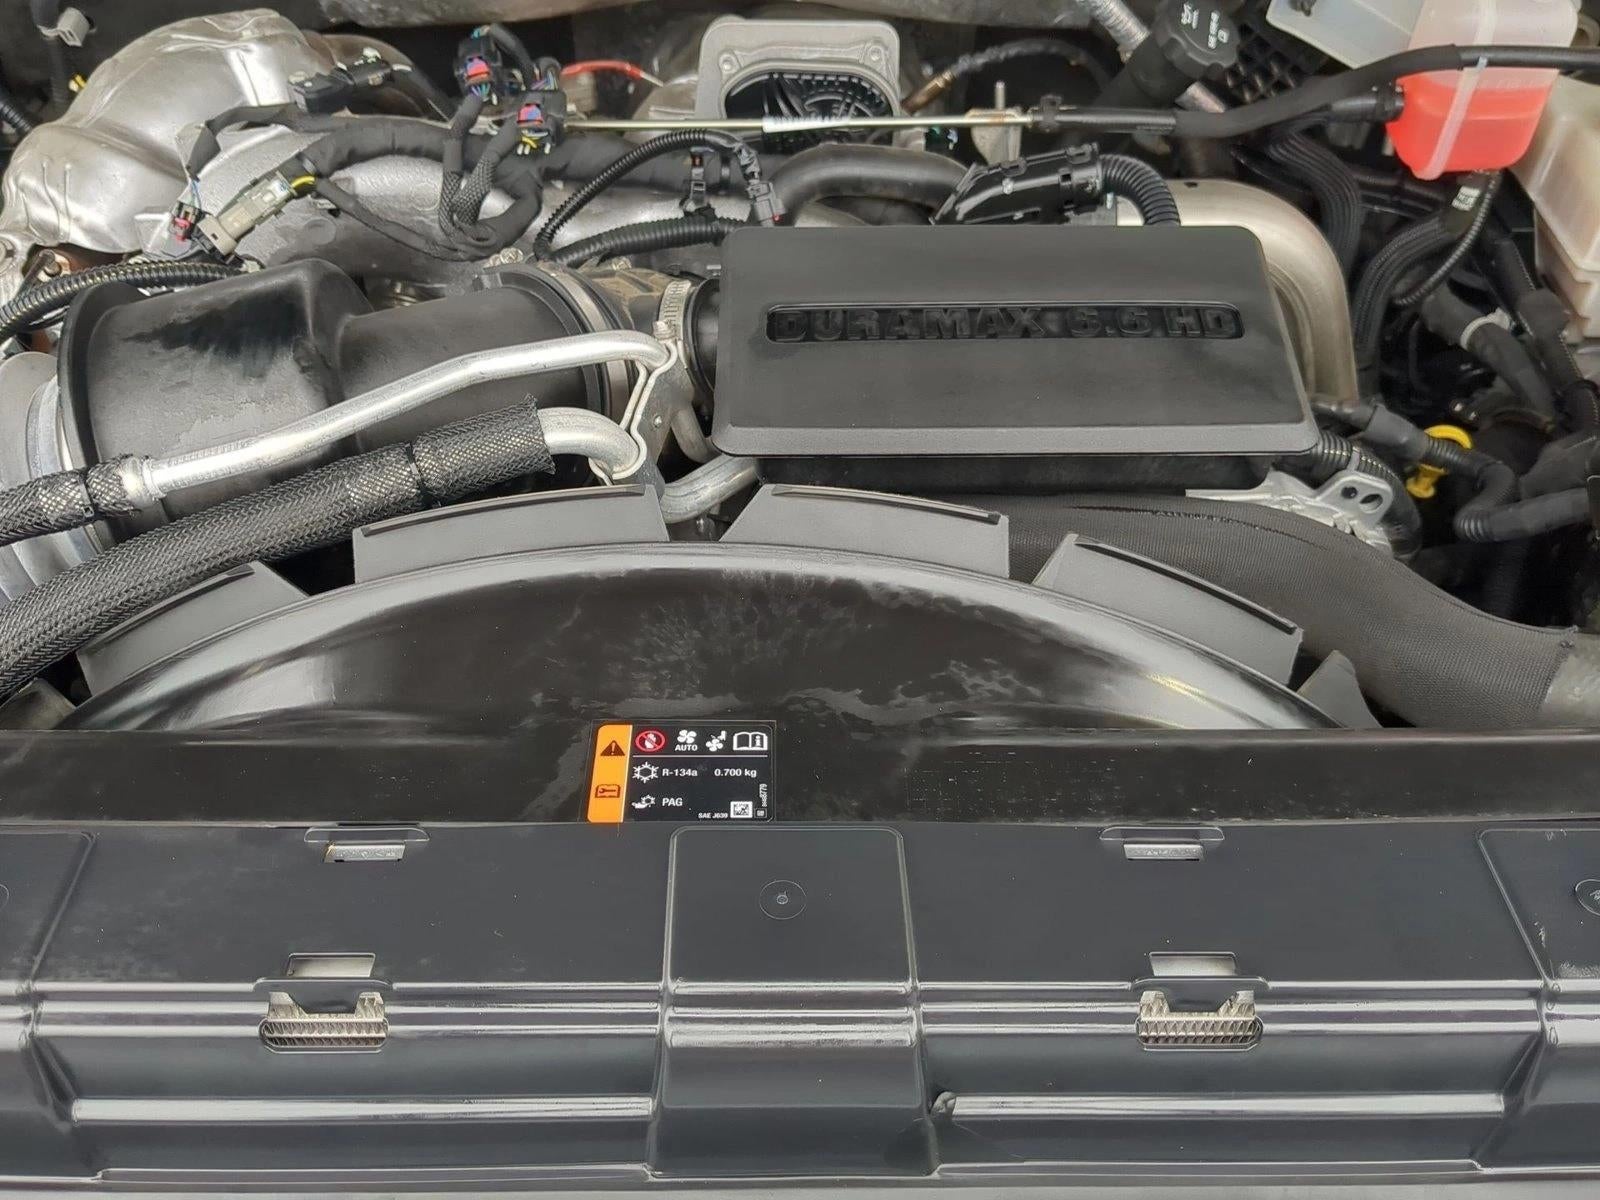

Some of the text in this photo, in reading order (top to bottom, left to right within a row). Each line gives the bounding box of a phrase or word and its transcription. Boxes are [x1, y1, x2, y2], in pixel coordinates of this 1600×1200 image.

[774, 307, 1238, 341] DURAMAX 6.6 HD
[674, 744, 698, 752] AUTO
[662, 768, 757, 778] R-134a 0.700 kg
[661, 797, 683, 807] PAG
